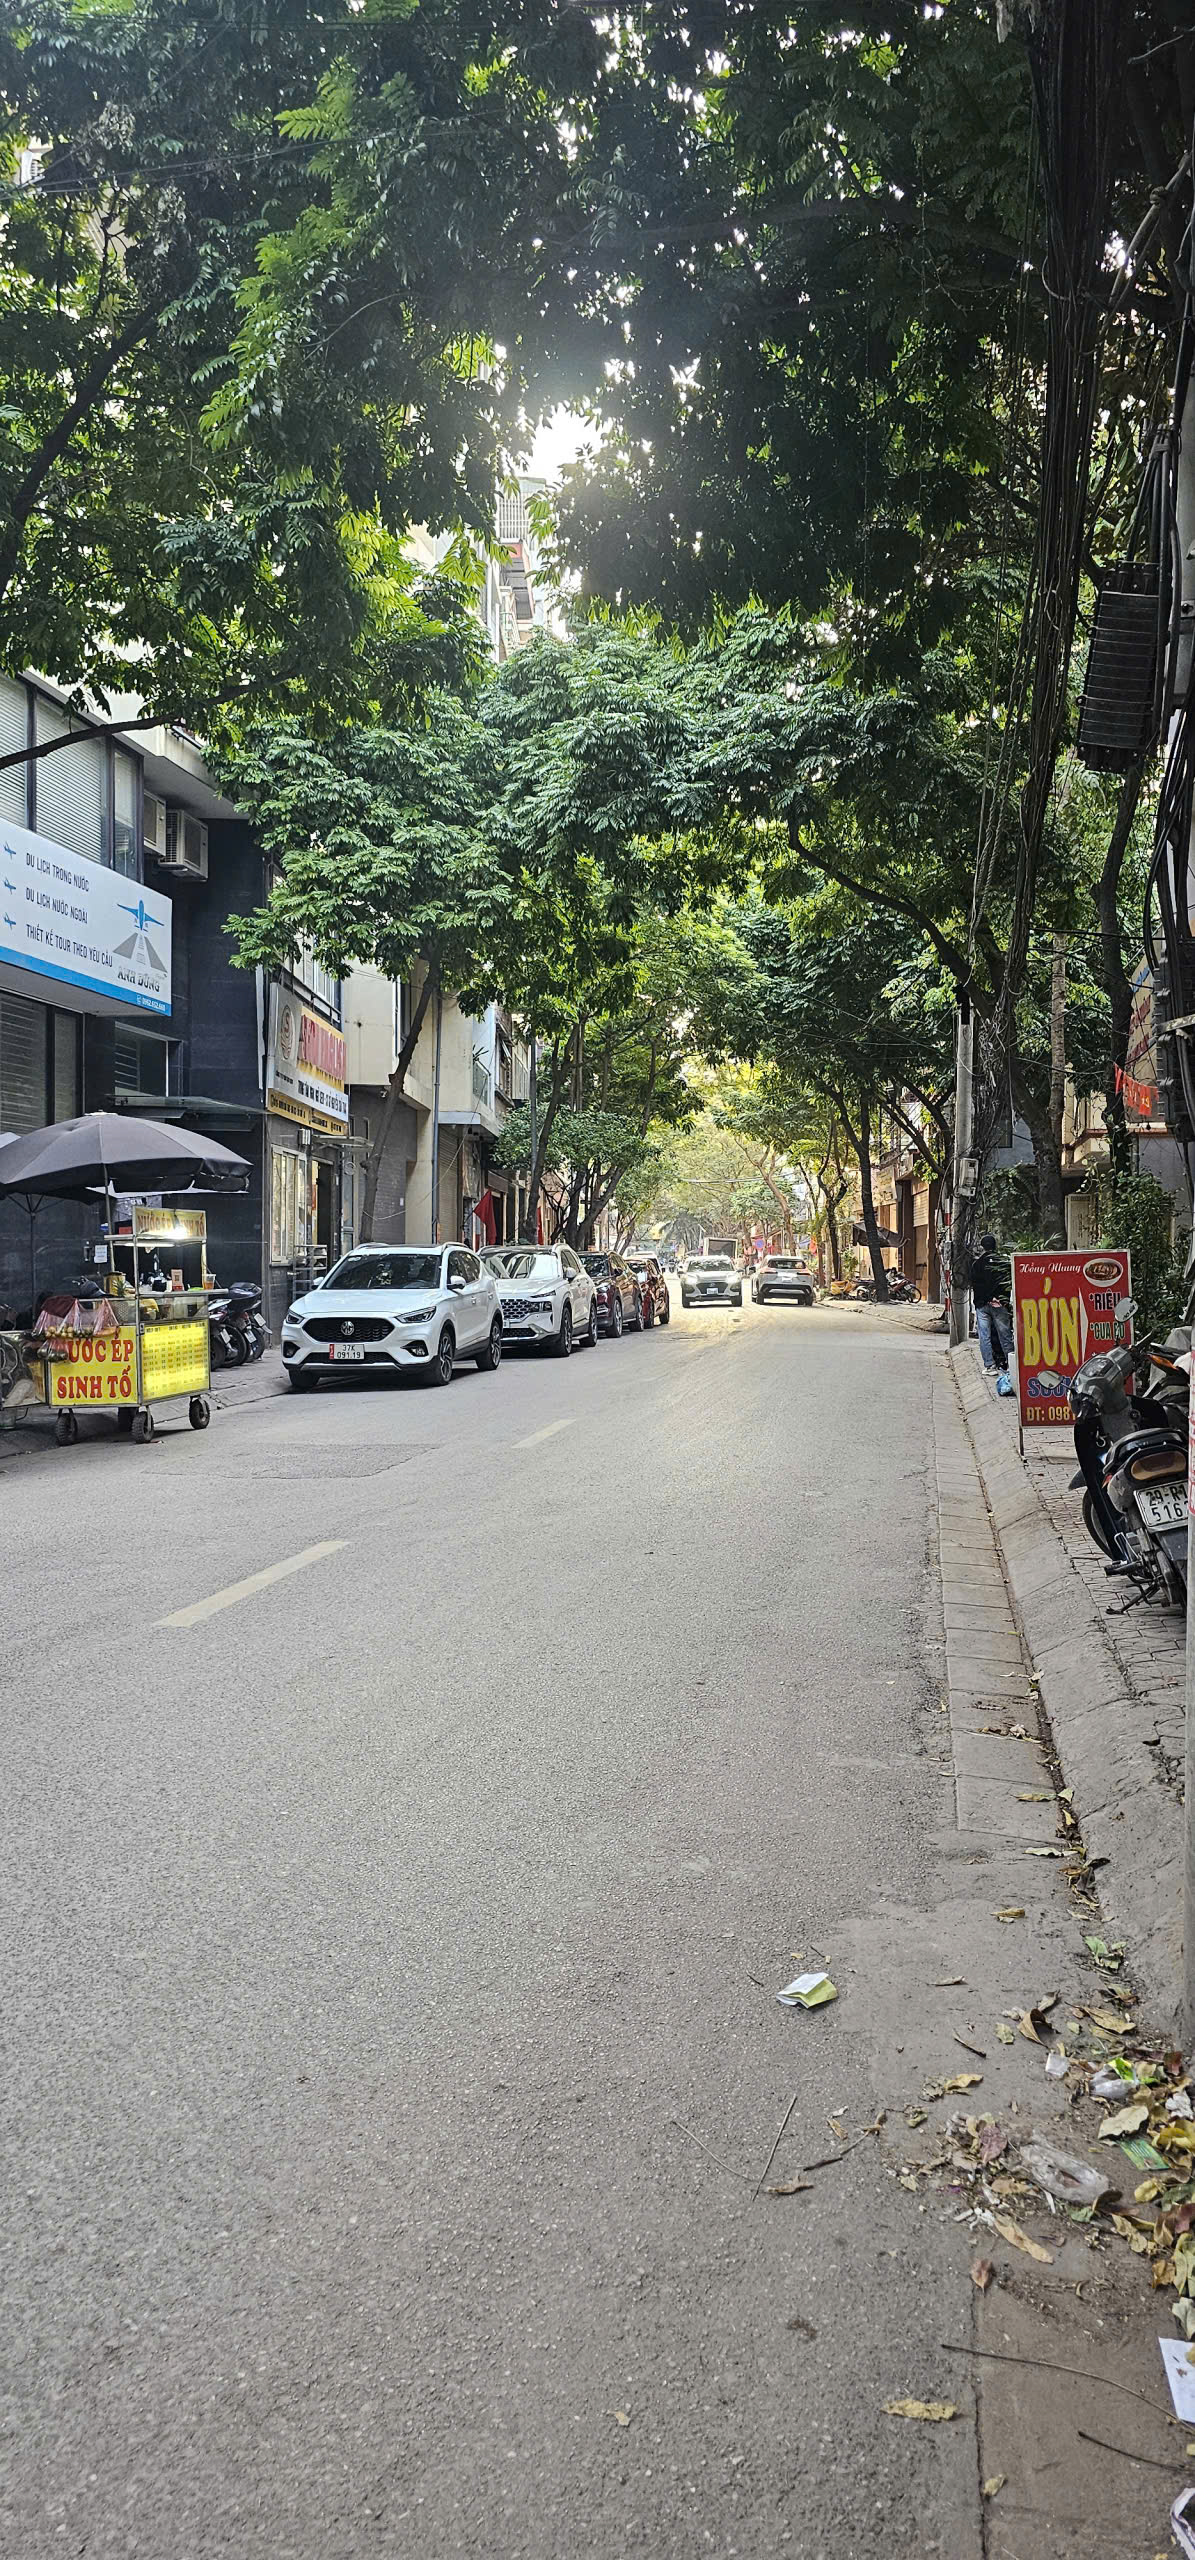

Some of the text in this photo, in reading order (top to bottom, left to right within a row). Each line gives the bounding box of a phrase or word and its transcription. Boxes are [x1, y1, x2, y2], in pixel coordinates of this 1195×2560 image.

[53, 864, 71, 884] TRONG
[55, 935, 71, 952] TOUR
[73, 941, 88, 958] THEO
[1021, 1276, 1079, 1366] BÚN
[67, 1325, 134, 1363] ƯỚC ÉP
[57, 1376, 102, 1399] SINH
[107, 1365, 132, 1398] TỐ
[1145, 1484, 1188, 1507] 29-R1
